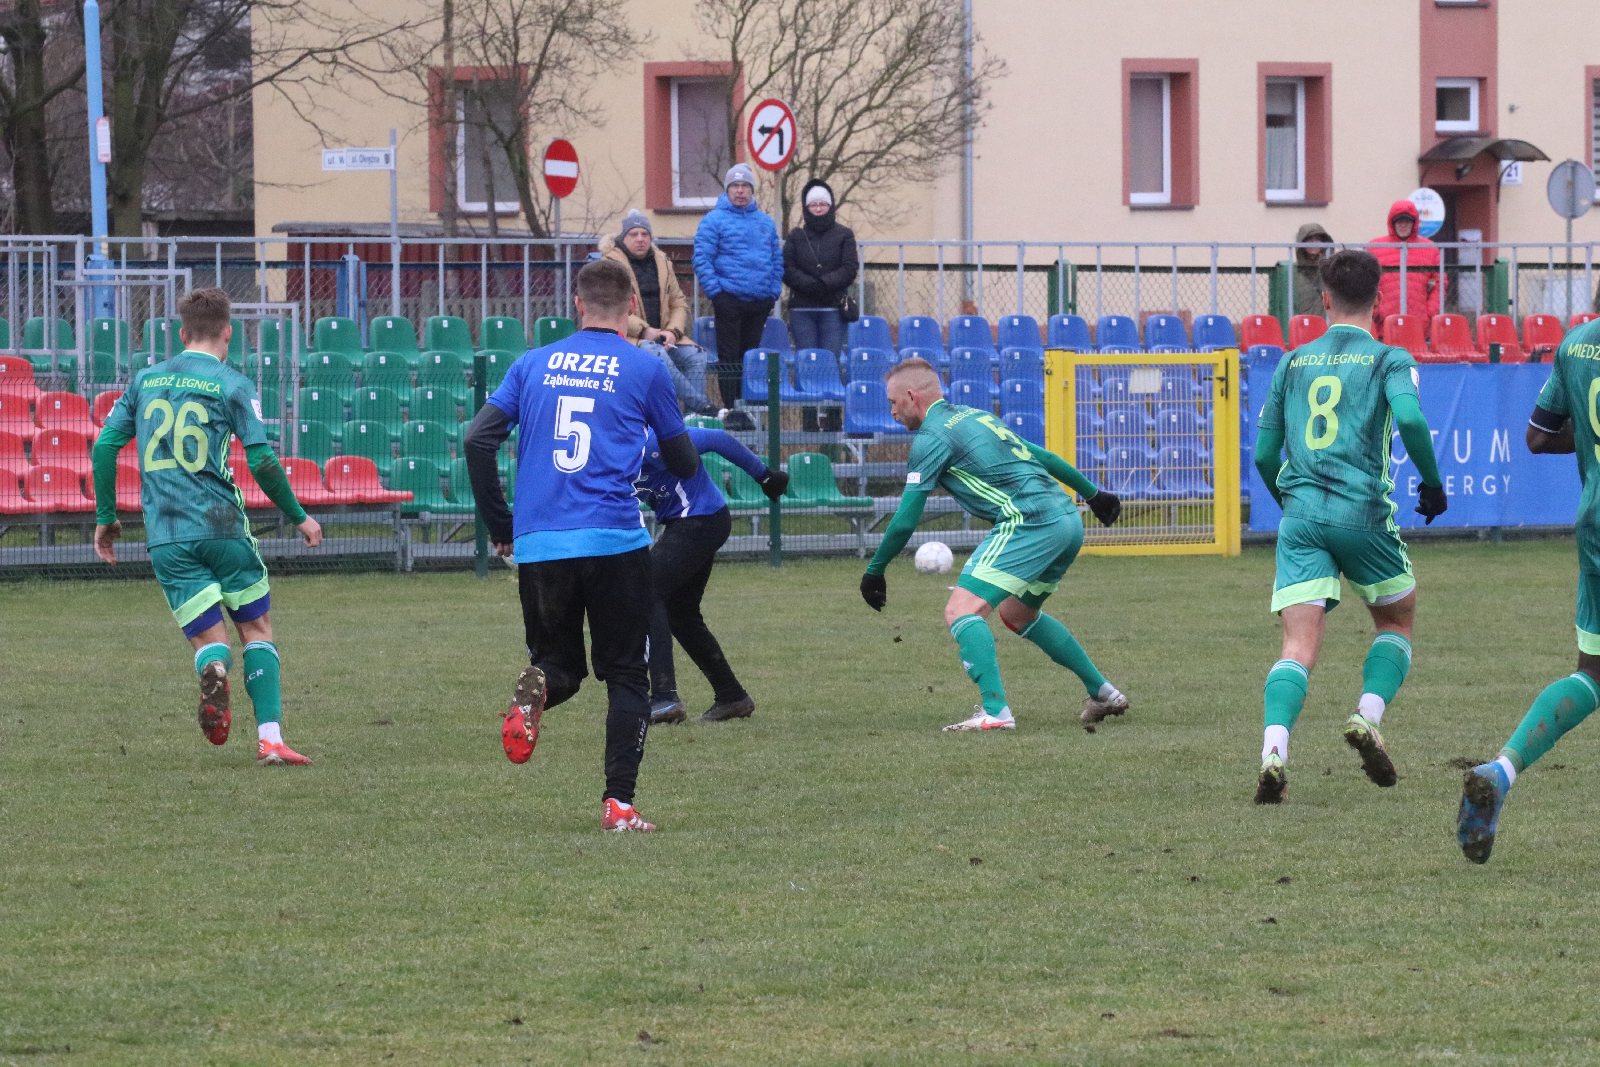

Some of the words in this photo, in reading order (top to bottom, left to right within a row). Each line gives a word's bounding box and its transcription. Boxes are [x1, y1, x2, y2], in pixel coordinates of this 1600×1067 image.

[1506, 164, 1519, 177] 21
[547, 351, 620, 377] ORZEŁ
[1289, 352, 1326, 369] MIEDŹ
[1326, 353, 1375, 366] LEGNICA
[143, 374, 176, 390] MIEDŹ
[175, 377, 221, 394] LEGNICA
[542, 373, 600, 389] Ząbkowice
[601, 376, 616, 393] Śl.
[1305, 375, 1343, 451] 8
[143, 398, 209, 473] 26
[552, 395, 596, 474] 5
[975, 414, 1032, 461] 5
[1390, 428, 1511, 465] OTUM
[1408, 474, 1511, 497] EERGY
